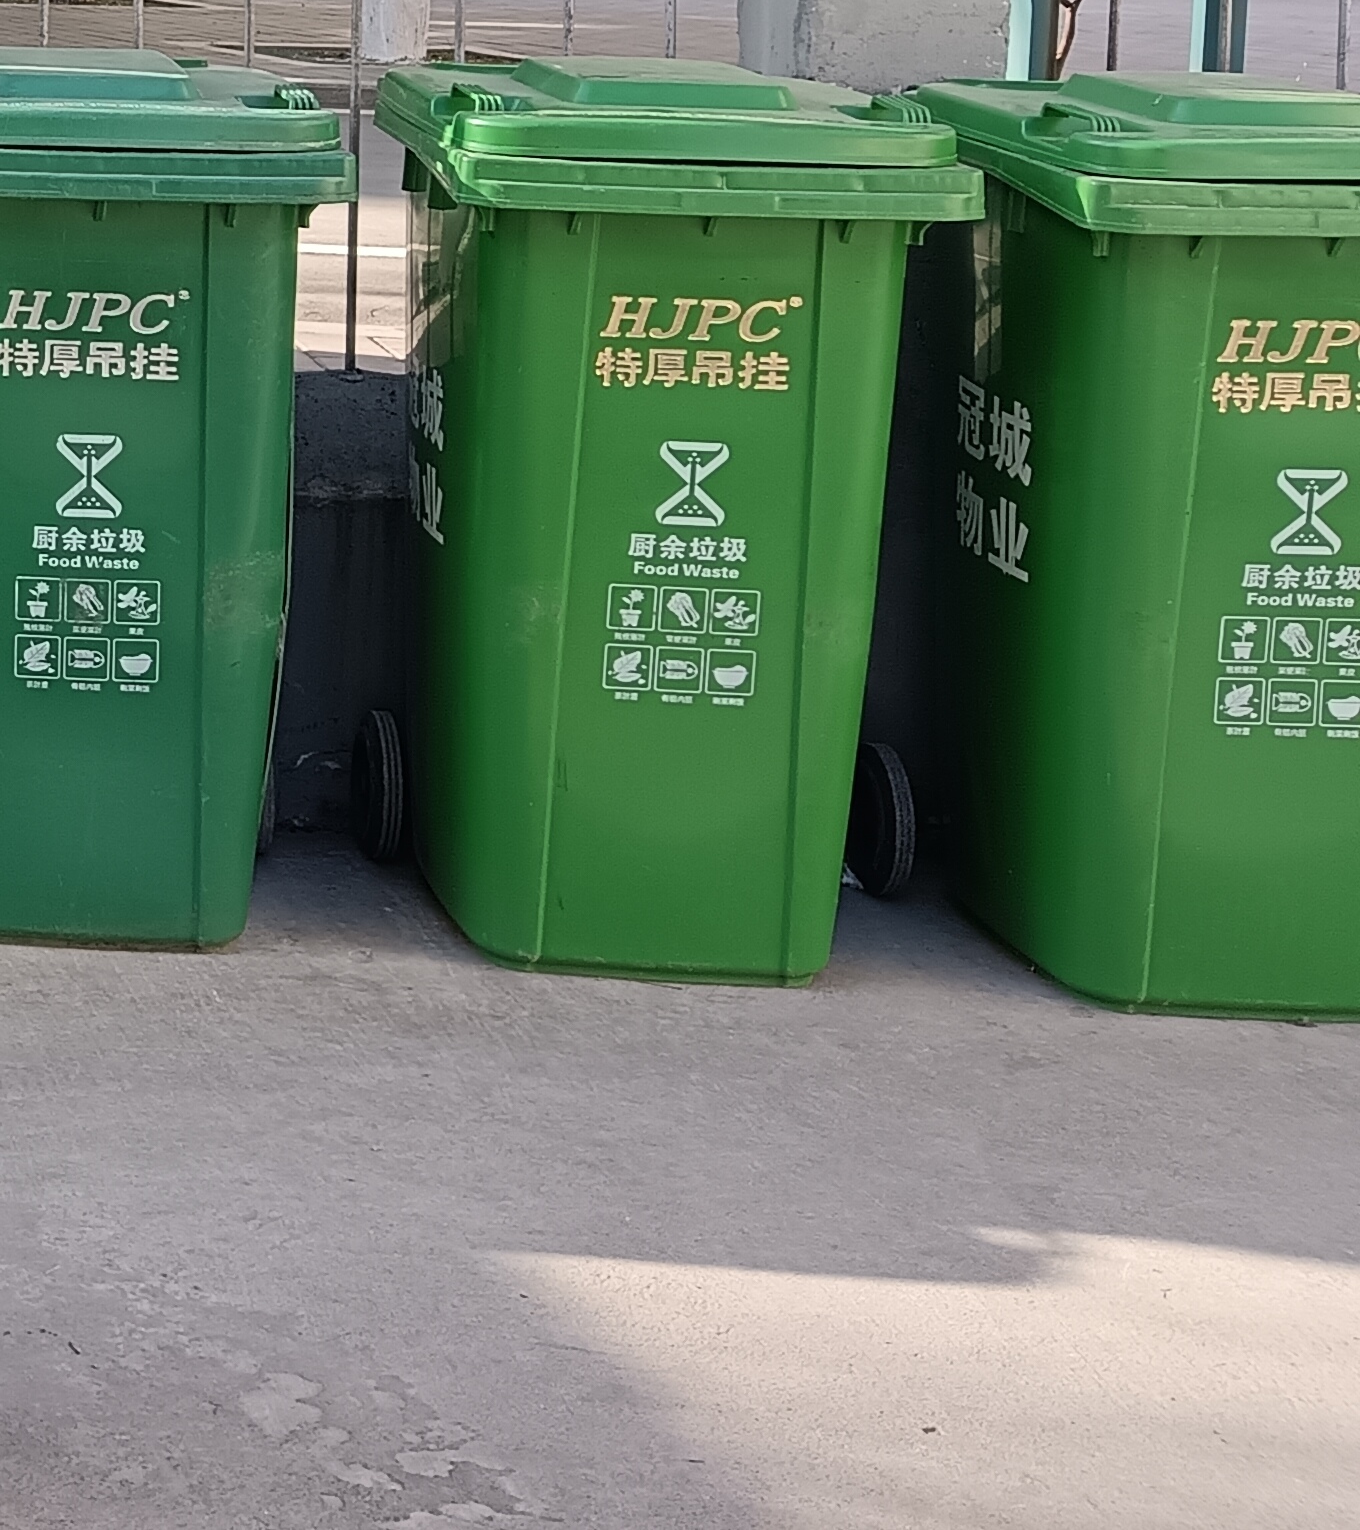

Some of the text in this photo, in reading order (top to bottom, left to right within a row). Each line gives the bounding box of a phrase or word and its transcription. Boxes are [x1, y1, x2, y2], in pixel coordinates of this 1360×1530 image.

[599, 295, 788, 343] HJPC
[1216, 319, 1360, 365] HJP
[595, 347, 791, 391] 特厚吊挂
[1211, 372, 1360, 413] 特厚吊
[957, 375, 1032, 487] 冠城
[31, 525, 147, 554] 厨余垃圾
[956, 471, 1030, 584] 物业
[38, 553, 140, 571] Food Waste
[627, 533, 748, 563] 厨余垃圾
[633, 561, 741, 580] Food Waste
[1241, 563, 1360, 591] 厨余垃圾
[1246, 592, 1355, 609] Food Waste
